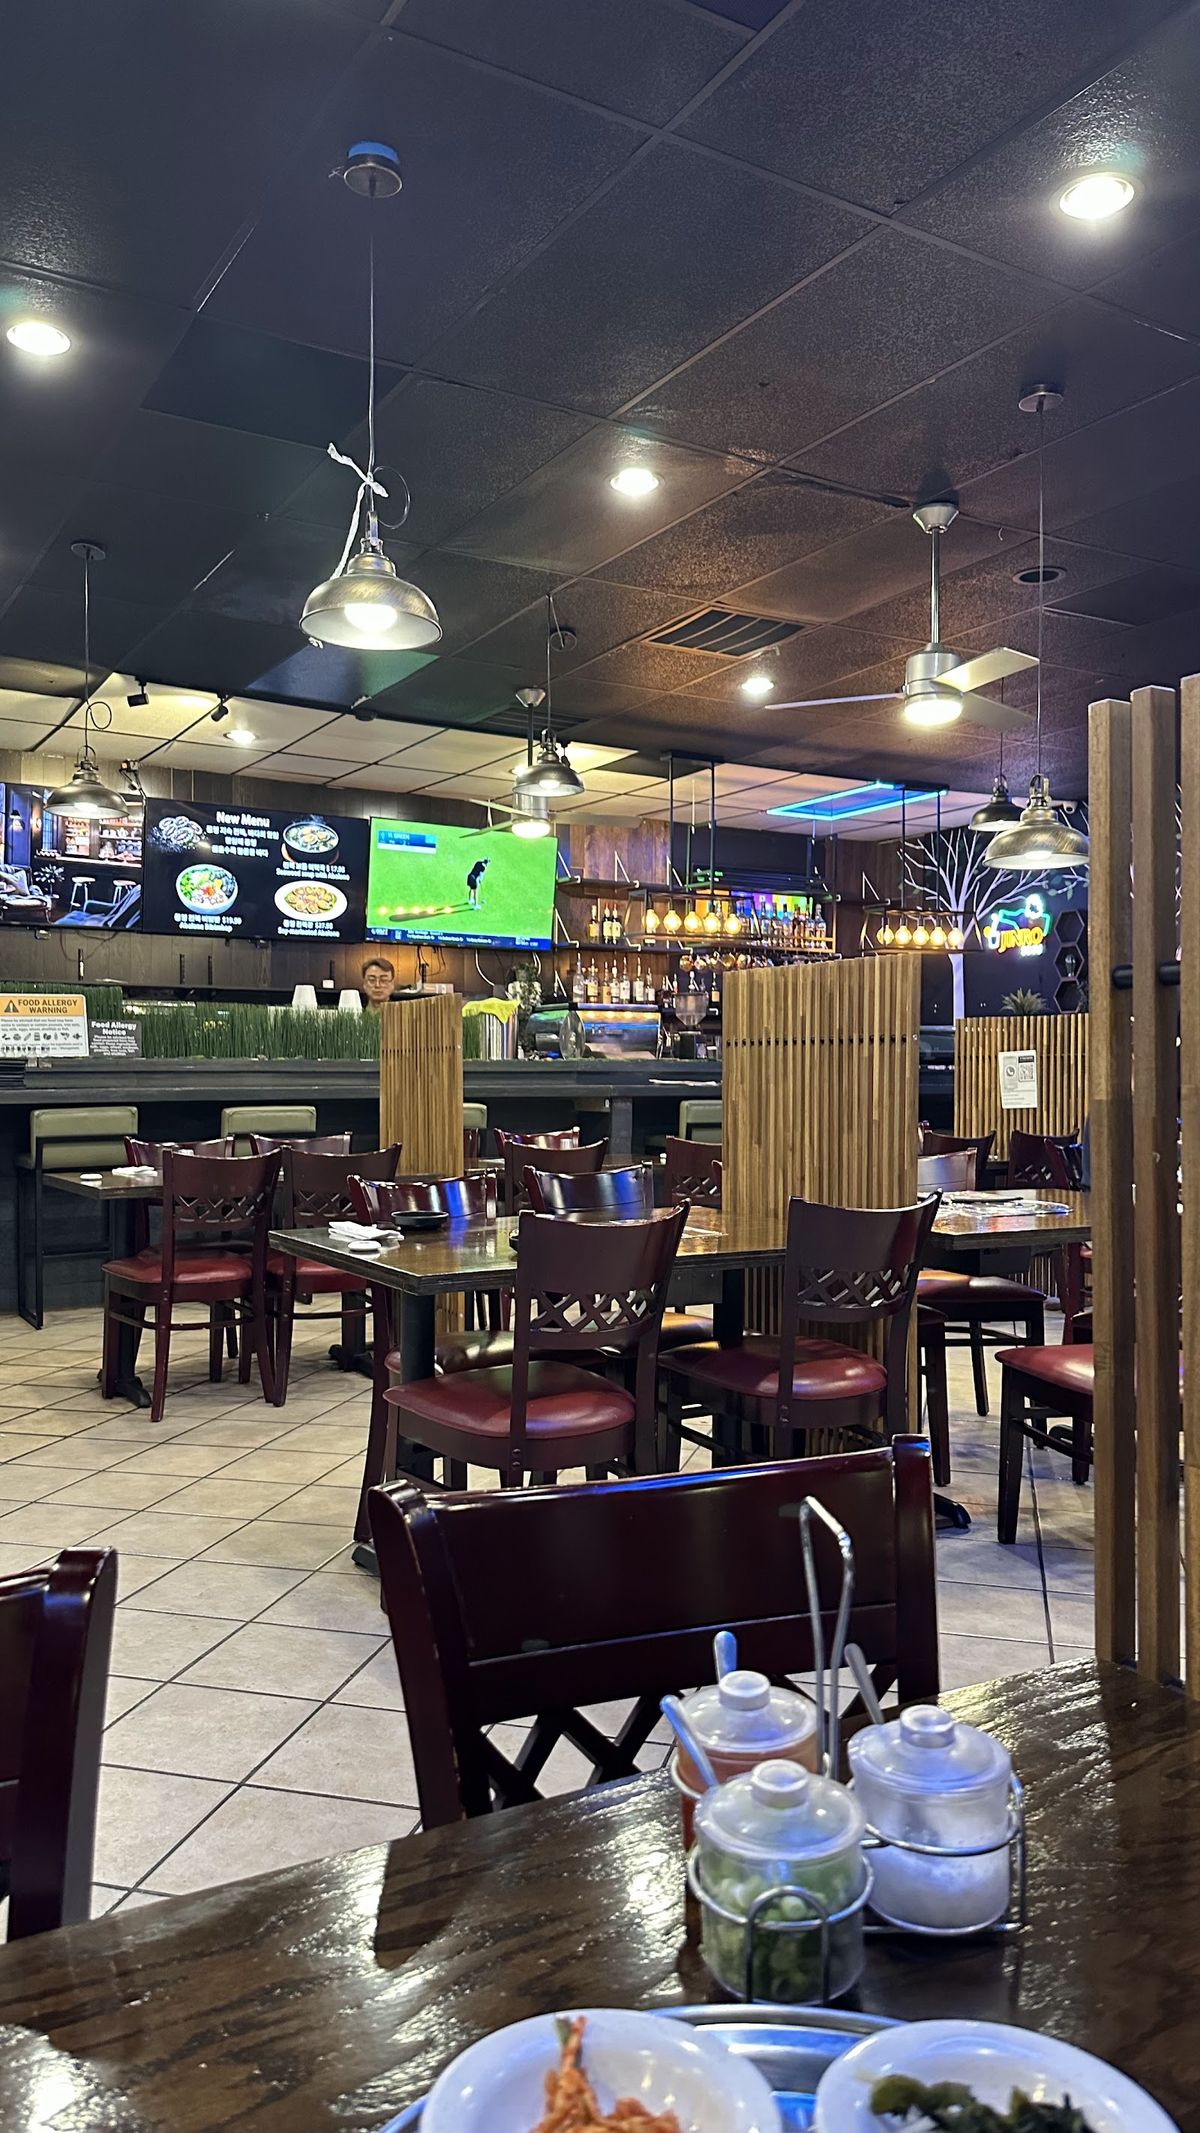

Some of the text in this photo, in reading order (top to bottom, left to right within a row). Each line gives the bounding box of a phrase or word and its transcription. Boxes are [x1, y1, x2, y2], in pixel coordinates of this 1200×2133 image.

[216, 811, 270, 828] New Menu
[998, 926, 1044, 953] JINRO
[42, 999, 78, 1007] ALLERGY
[111, 1021, 137, 1031] Allergy
[102, 1028, 127, 1036] Notice
